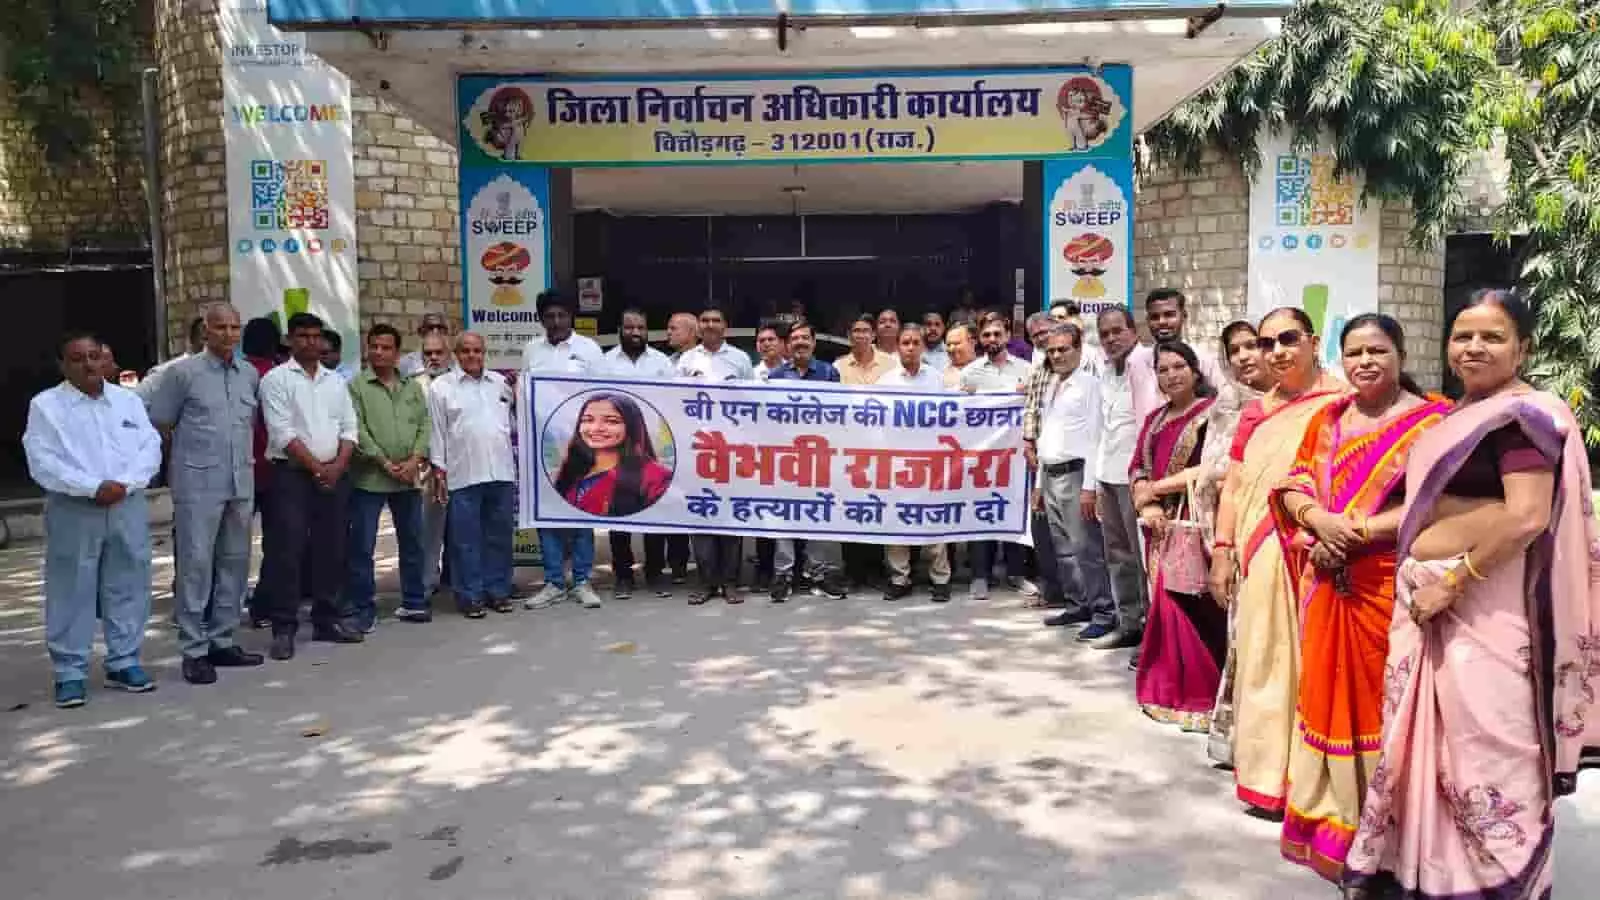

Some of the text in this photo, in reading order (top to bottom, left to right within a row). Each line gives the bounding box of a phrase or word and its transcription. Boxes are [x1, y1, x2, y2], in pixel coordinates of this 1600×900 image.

[231, 104, 344, 123] WELCOME
[547, 80, 1042, 123] जिला निर्वाचन अधिकारी कार्यालय
[472, 220, 536, 234] SWEEP
[1056, 211, 1121, 225] SWEEP
[682, 391, 1024, 428] बी एन कॉलेज की NCC छात्रा
[692, 430, 1017, 491] वैभवी राजोरा
[685, 487, 1009, 525] के हत्यारों को सजा दो
